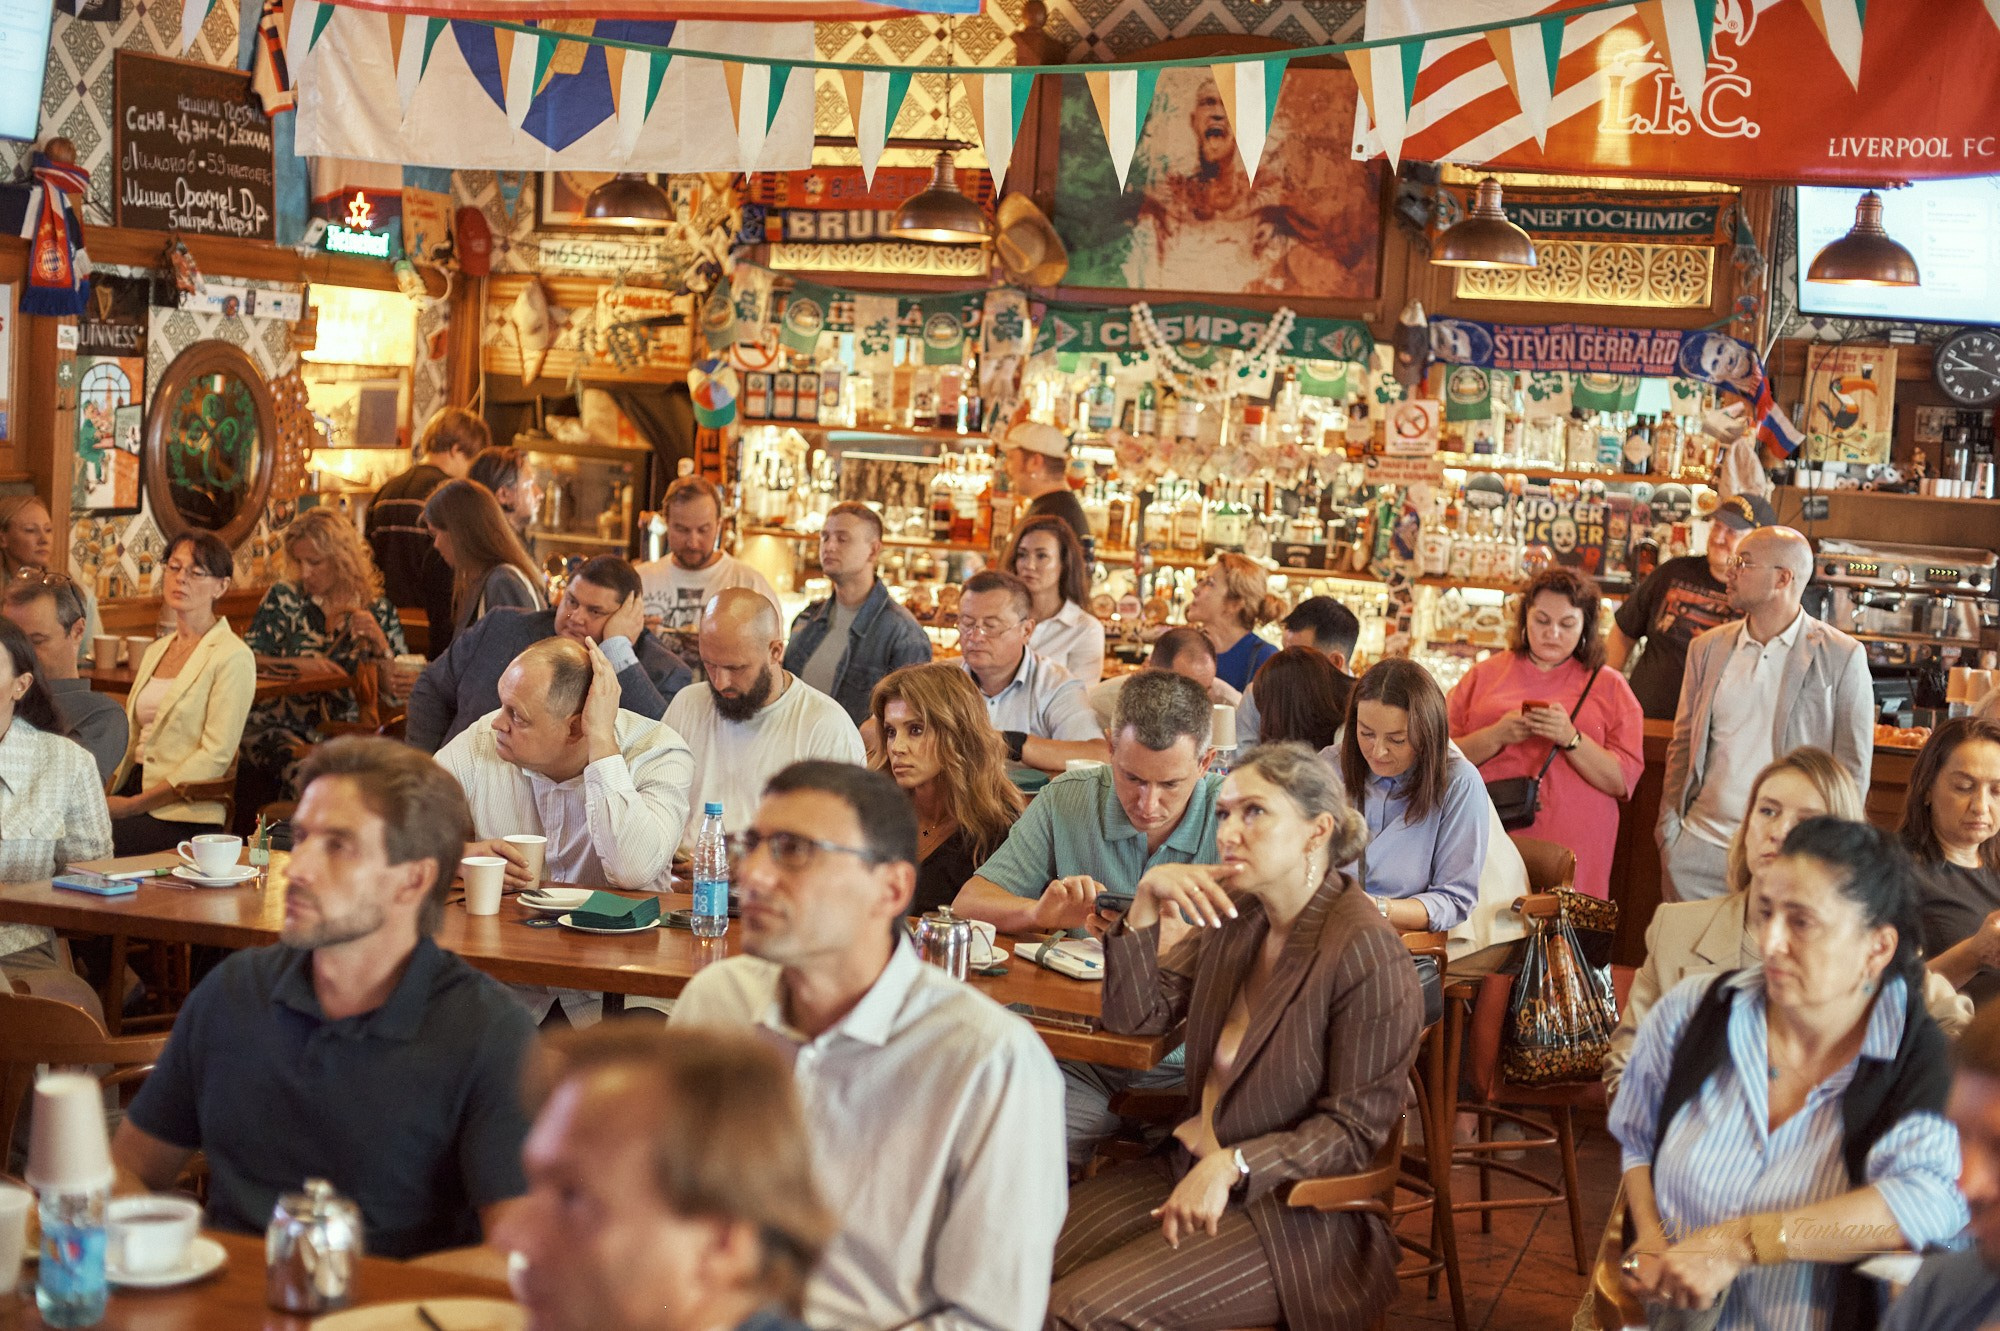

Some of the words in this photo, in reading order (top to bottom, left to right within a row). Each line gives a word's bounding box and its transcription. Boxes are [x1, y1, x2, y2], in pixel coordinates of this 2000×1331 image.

[126, 105, 165, 132] Саня
[1828, 137, 1953, 158] LIVERPOOL
[1963, 136, 1996, 158] FC
[122, 177, 175, 208] Миша
[168, 209, 179, 229] 5
[1519, 207, 1704, 231] NEFTOCHIMIC
[77, 322, 139, 349] UINNESS
[1493, 332, 1577, 362] STEVEN
[1579, 335, 1680, 365] GERRARD
[1526, 500, 1604, 523] JOKER
